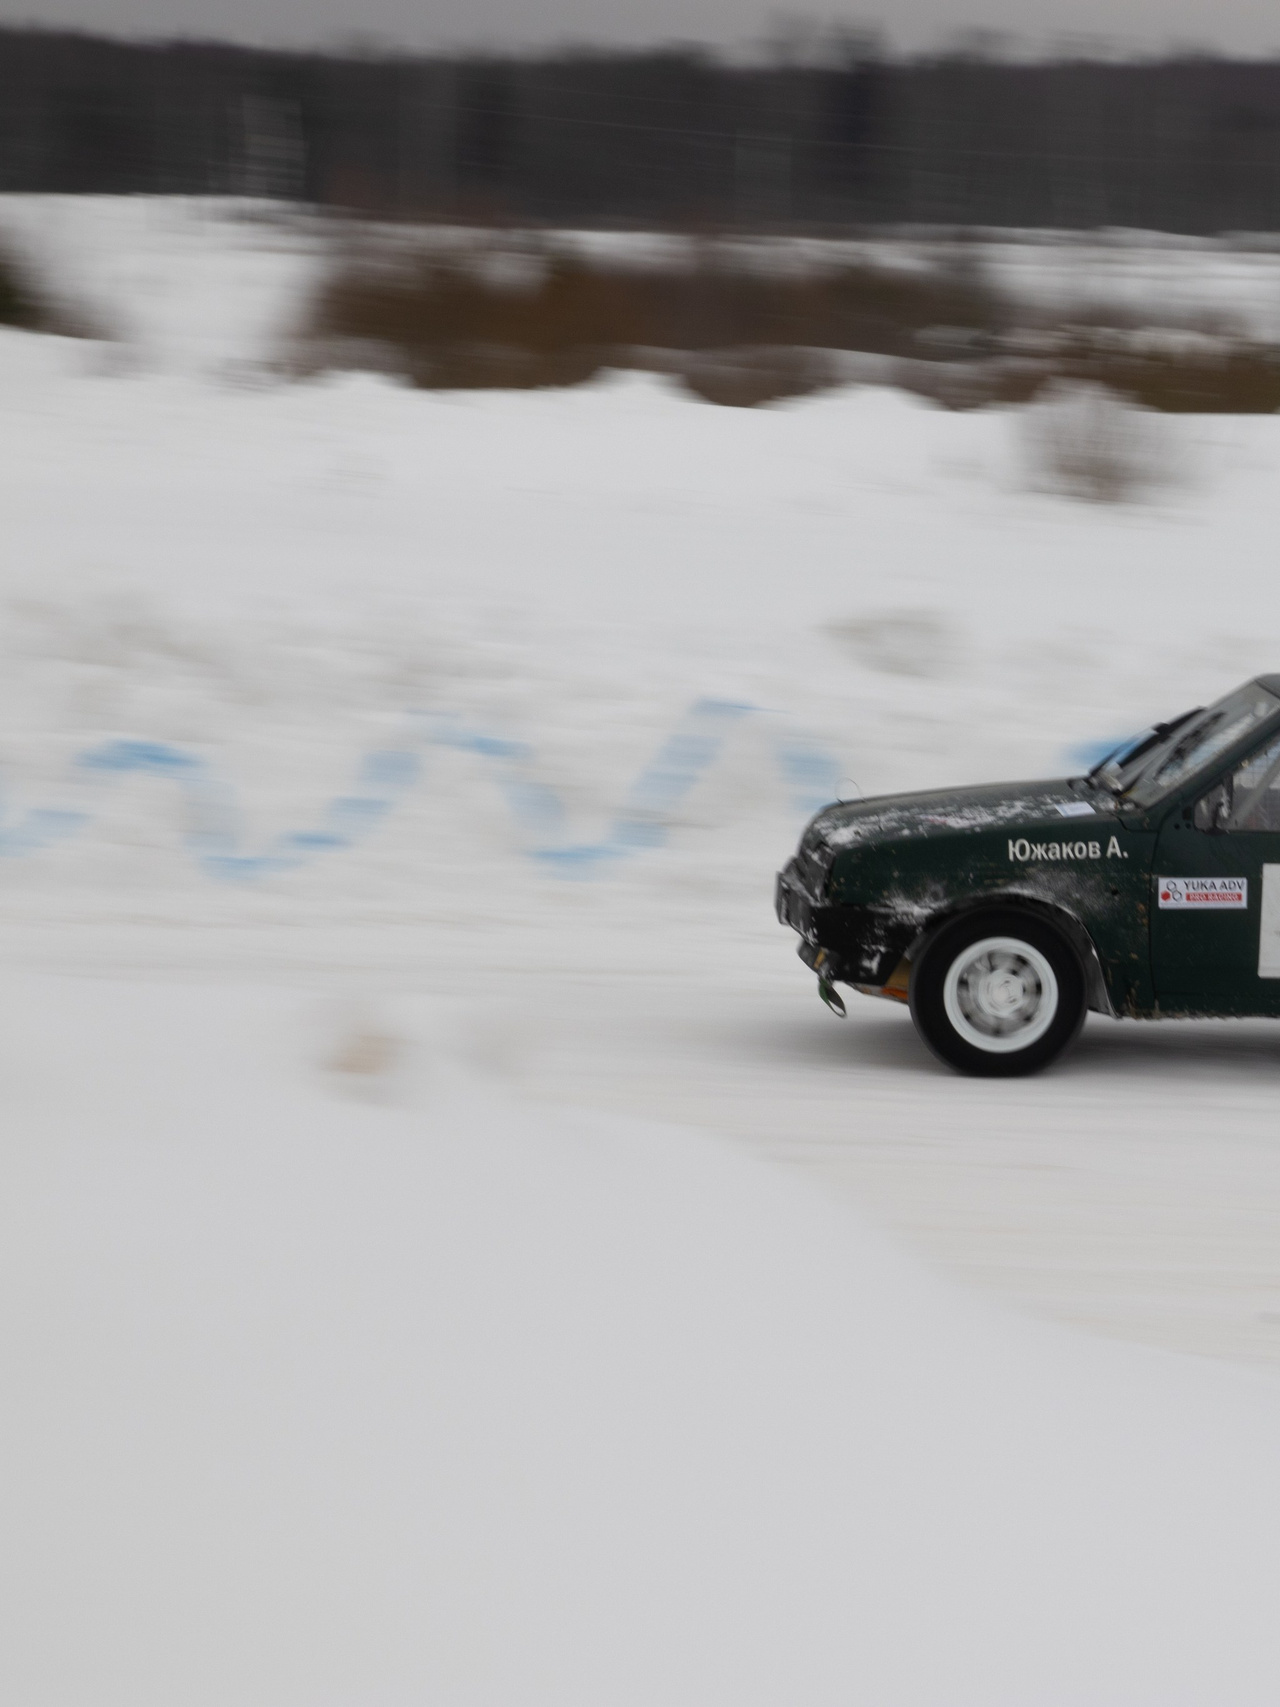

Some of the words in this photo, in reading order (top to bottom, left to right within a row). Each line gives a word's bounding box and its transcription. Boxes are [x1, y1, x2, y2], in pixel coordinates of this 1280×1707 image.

[1008, 838, 1101, 862] Южаков
[1183, 880, 1217, 891] YUKA
[1219, 880, 1244, 891] ADV
